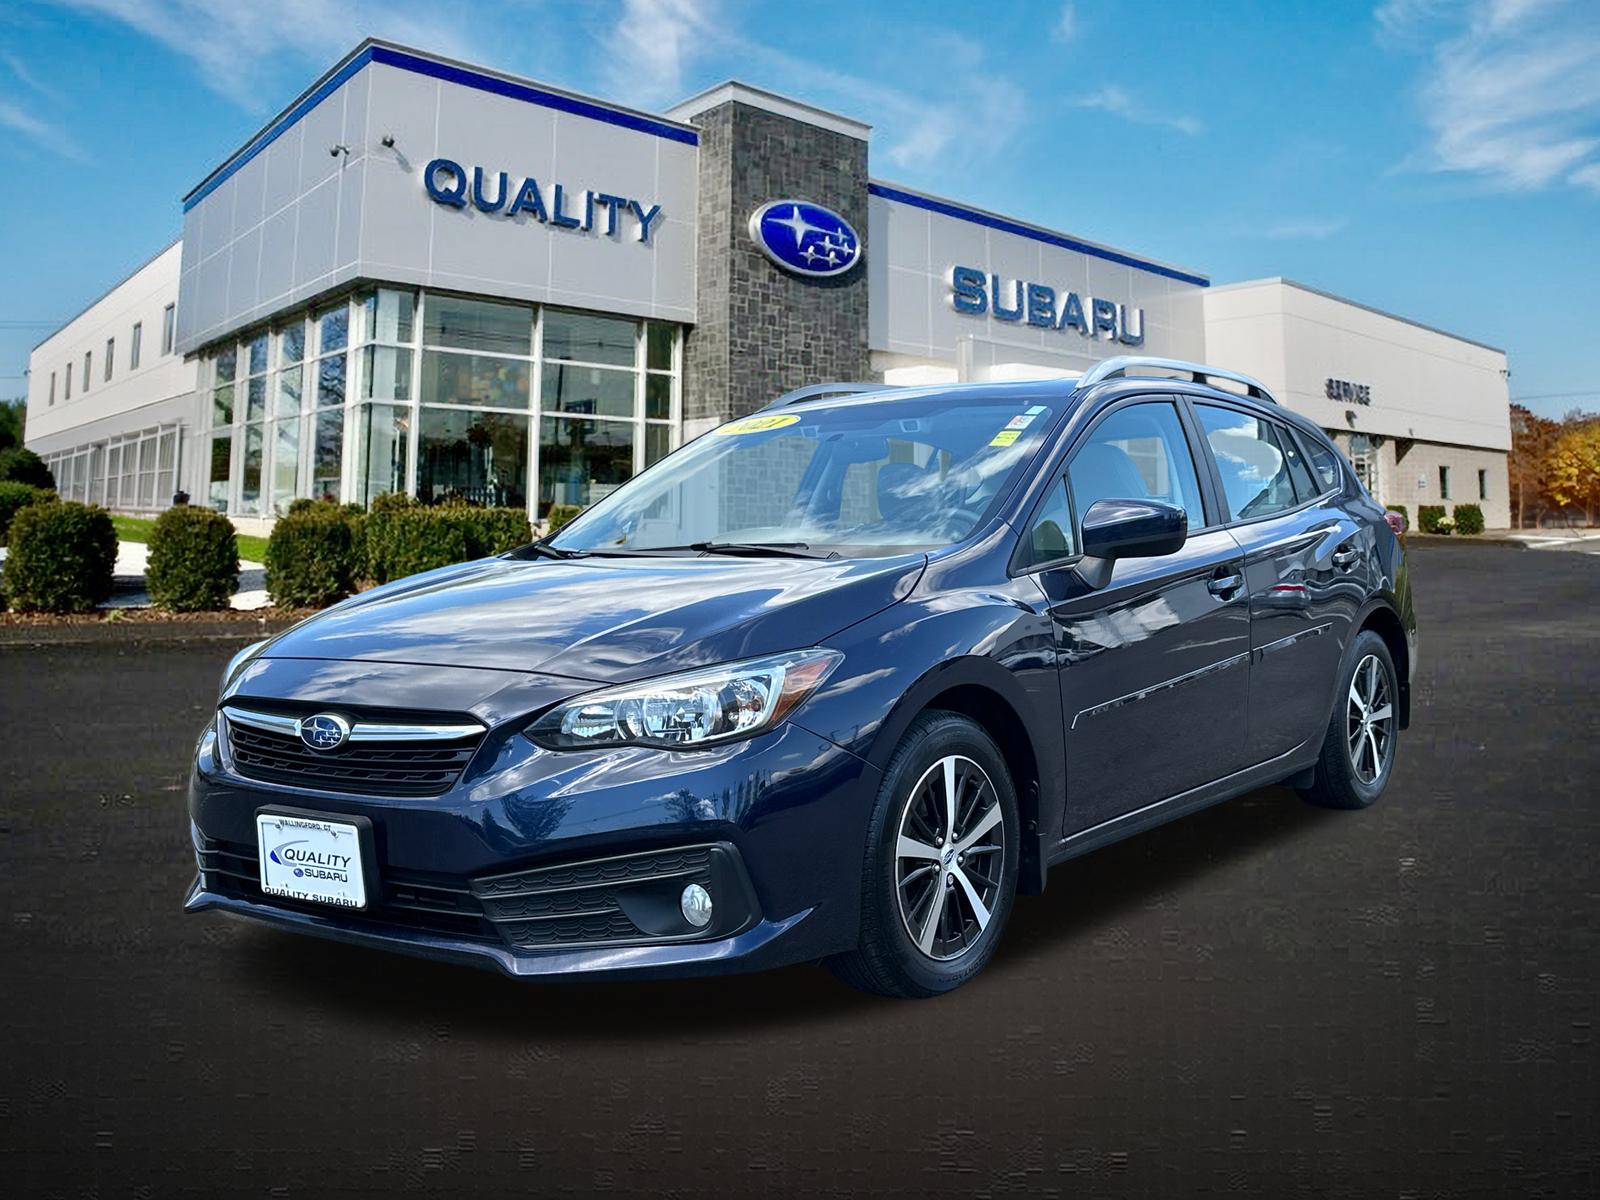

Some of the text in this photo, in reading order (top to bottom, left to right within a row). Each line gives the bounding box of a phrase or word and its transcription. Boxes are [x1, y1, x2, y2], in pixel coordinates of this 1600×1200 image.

[424, 158, 662, 243] QUALITY
[953, 266, 1145, 346] SUBARU
[284, 848, 351, 868] QUALITY
[304, 868, 348, 882] SUBARU
[264, 886, 358, 908] QUALITY SUBARU
